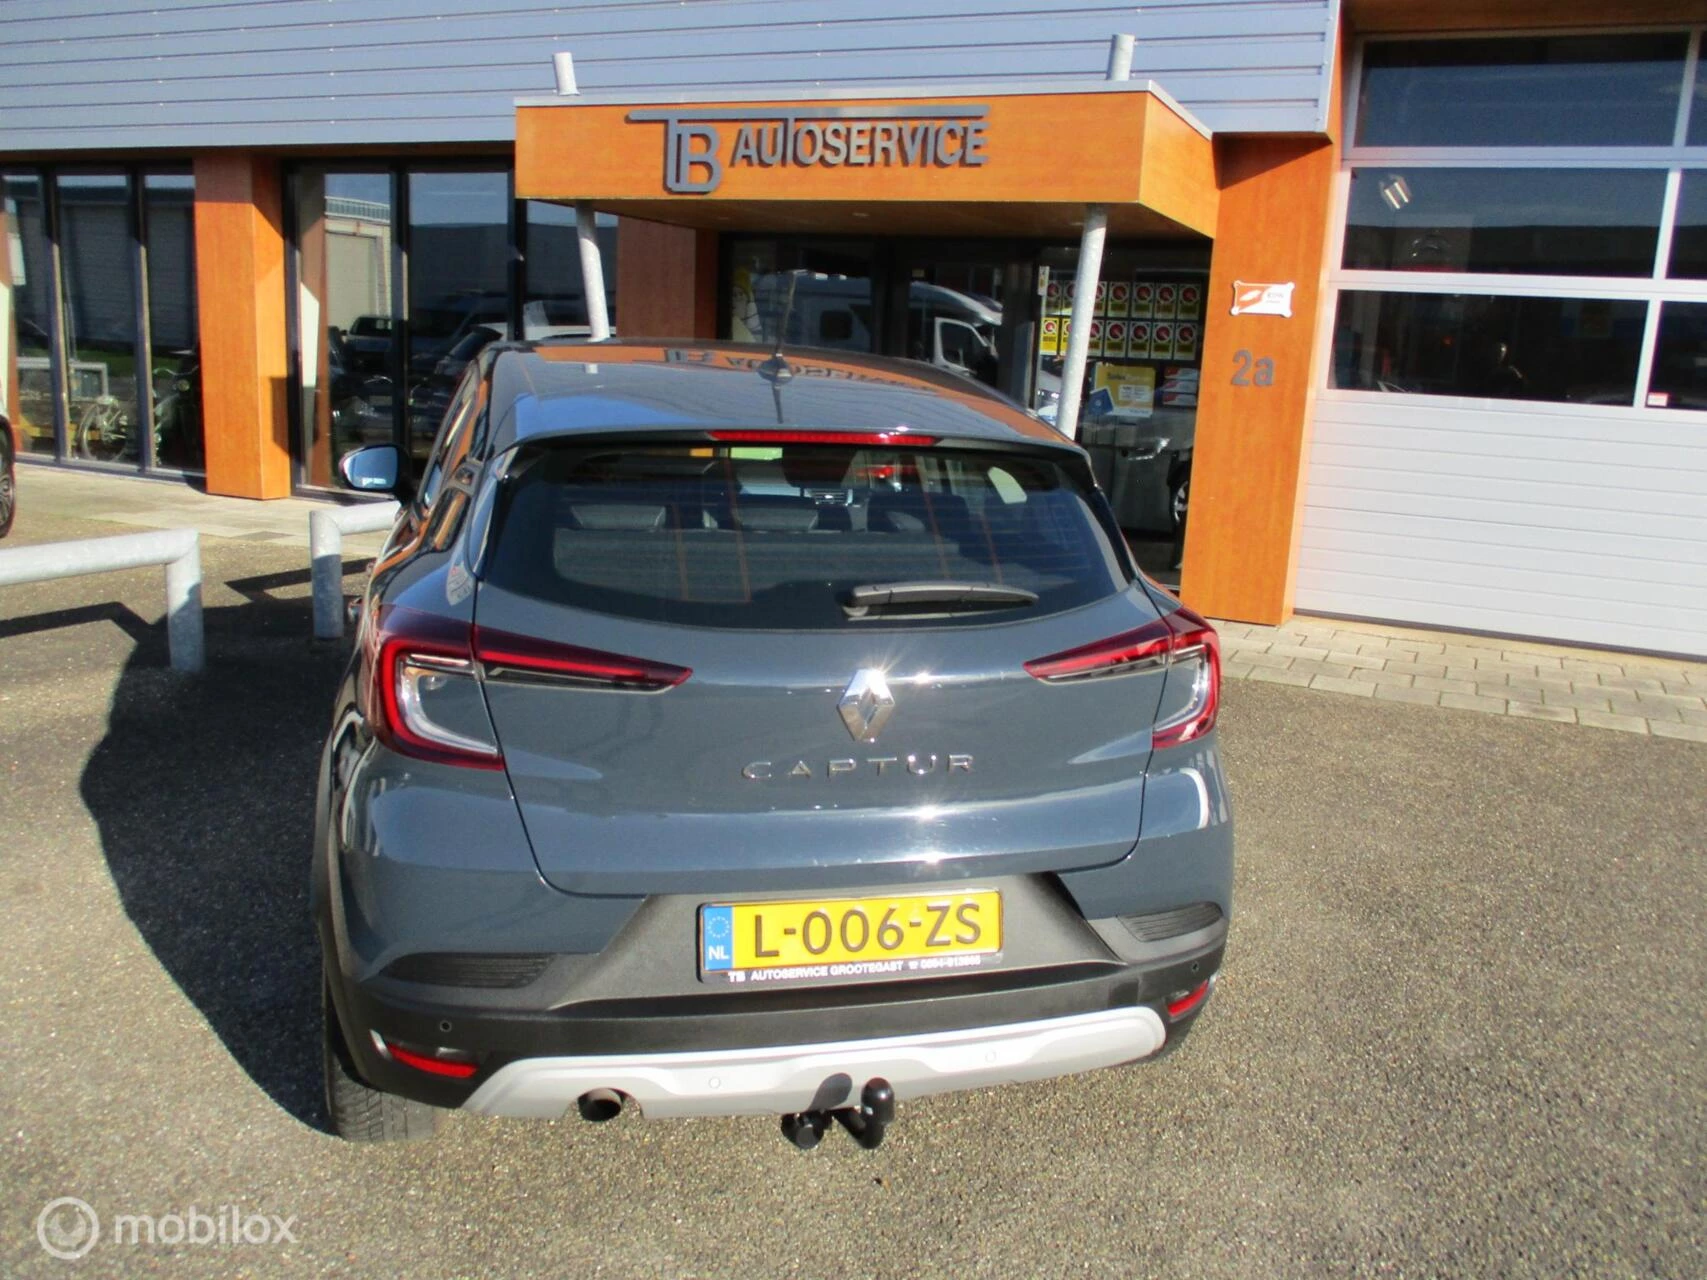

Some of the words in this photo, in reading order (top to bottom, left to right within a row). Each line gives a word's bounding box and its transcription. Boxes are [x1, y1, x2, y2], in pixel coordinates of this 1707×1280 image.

[626, 105, 722, 195] TB
[732, 117, 991, 168] AUTOSERVICE
[1230, 349, 1275, 387] 2a
[741, 753, 974, 779] CAPTUR
[753, 903, 982, 959] L-006-ZS
[708, 945, 730, 961] NL
[750, 966, 829, 982] AUTOSERVICE
[829, 959, 904, 976] GROOTEGAST
